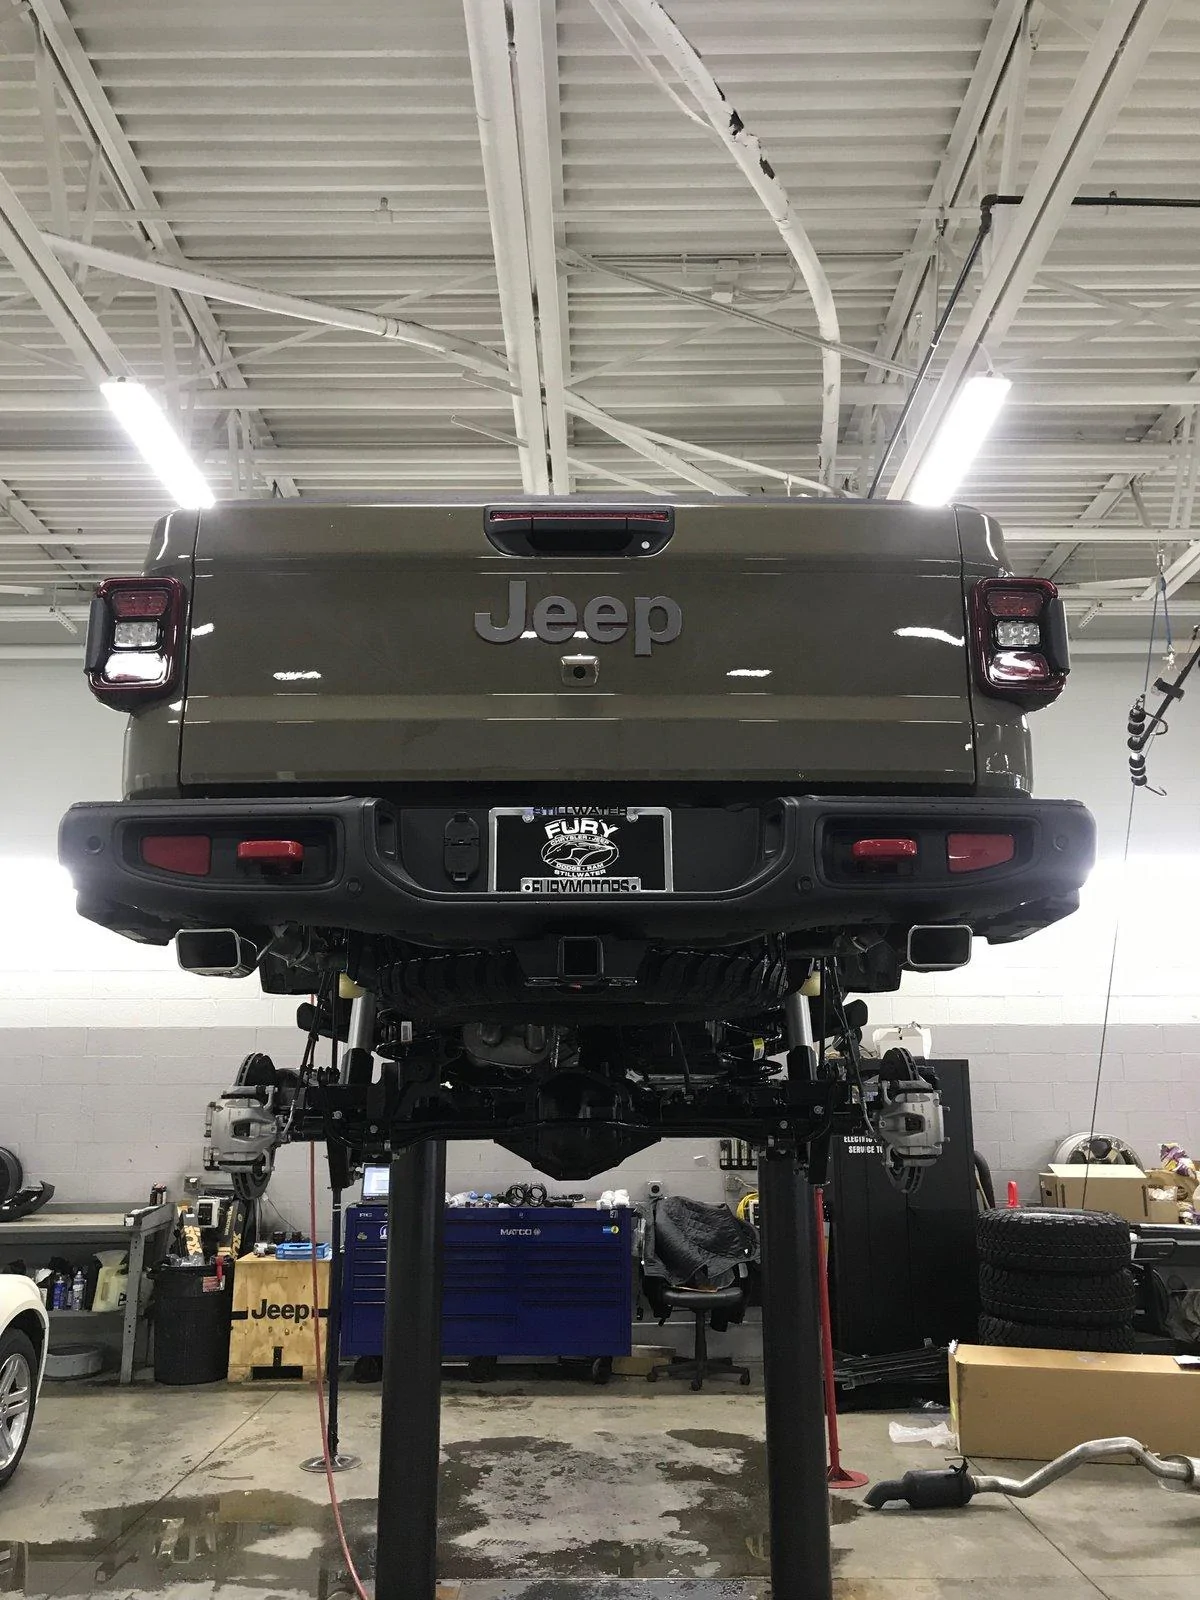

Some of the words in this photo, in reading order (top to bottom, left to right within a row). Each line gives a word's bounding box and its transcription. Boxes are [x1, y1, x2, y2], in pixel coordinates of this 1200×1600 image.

[474, 580, 683, 658] Jeep
[534, 806, 626, 816] STILLWATER
[544, 818, 619, 840] FURY
[550, 834, 588, 846] CHRYSLER
[591, 835, 610, 845] JEEP
[556, 862, 581, 871] DODGE
[586, 861, 604, 871] RAM
[553, 869, 607, 878] STILLWATER
[848, 1145, 875, 1154] SERVICE
[500, 1228, 532, 1236] MATCO
[251, 1298, 310, 1324] Jeep
